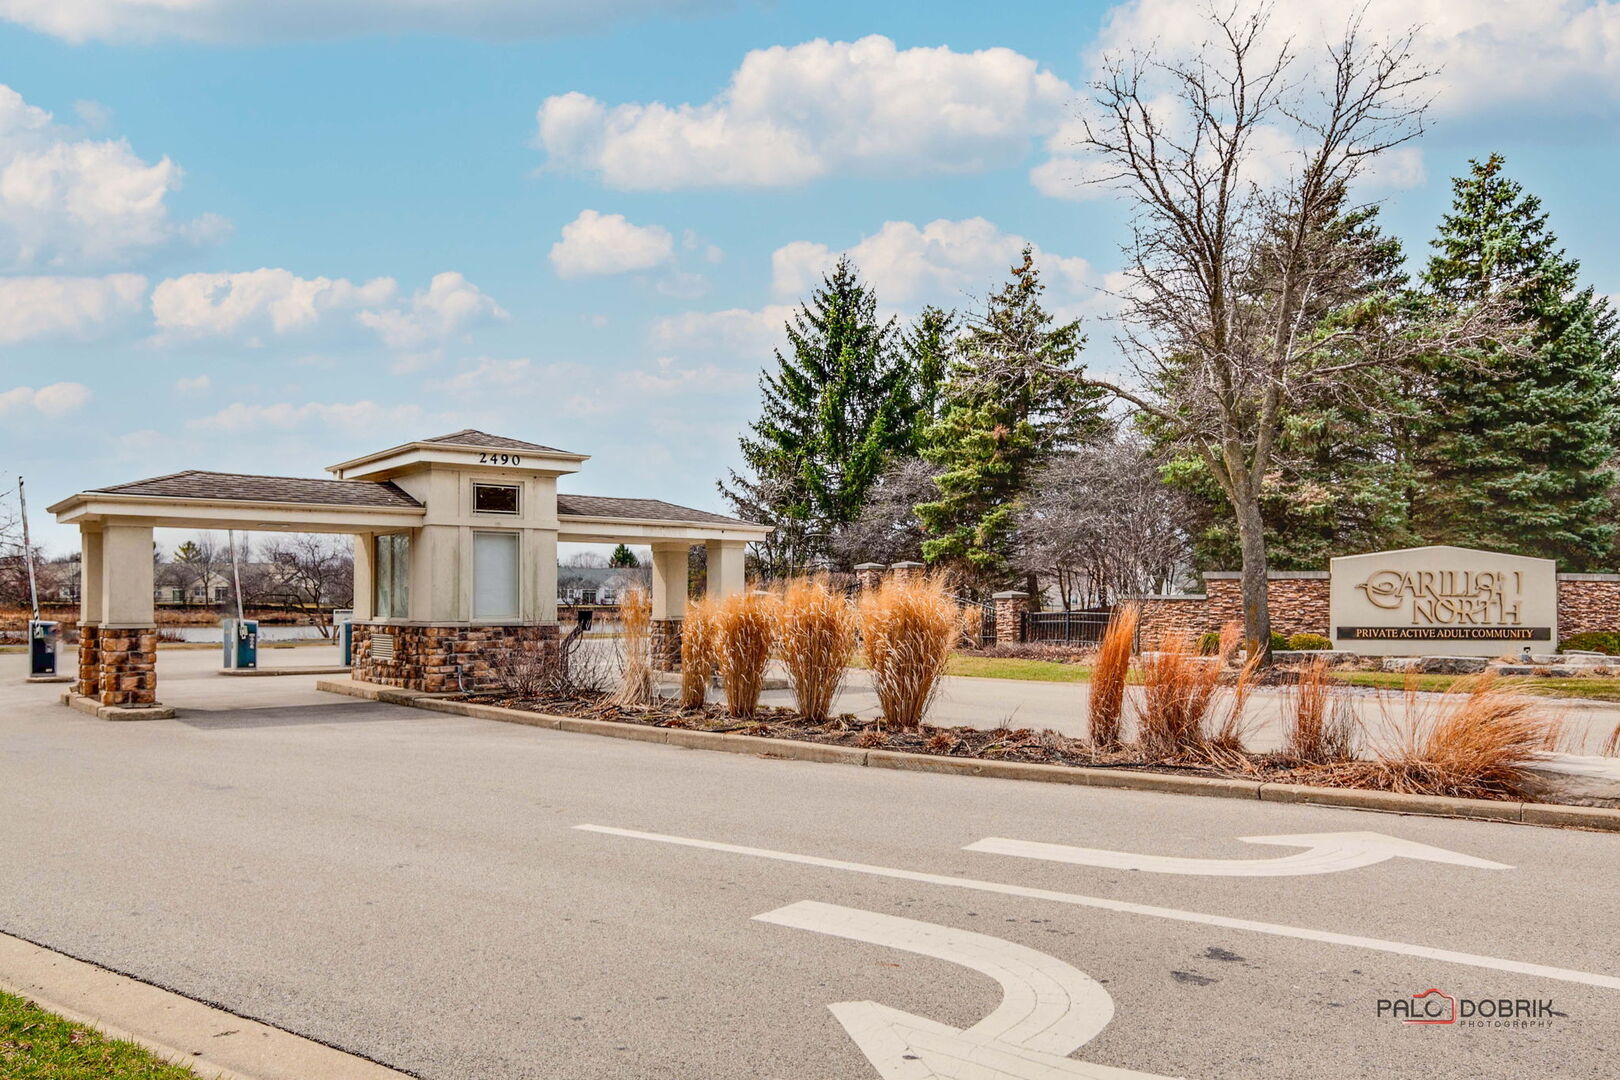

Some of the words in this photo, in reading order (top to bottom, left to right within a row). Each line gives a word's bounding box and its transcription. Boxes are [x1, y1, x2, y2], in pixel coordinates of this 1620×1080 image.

[479, 452, 521, 466] 2490
[1412, 594, 1522, 625] NORTH
[1355, 628, 1398, 639] PRIVATE
[1399, 628, 1436, 639] ACTIVE
[1437, 628, 1470, 639] ADULT
[1471, 628, 1534, 639] COMMUNITY
